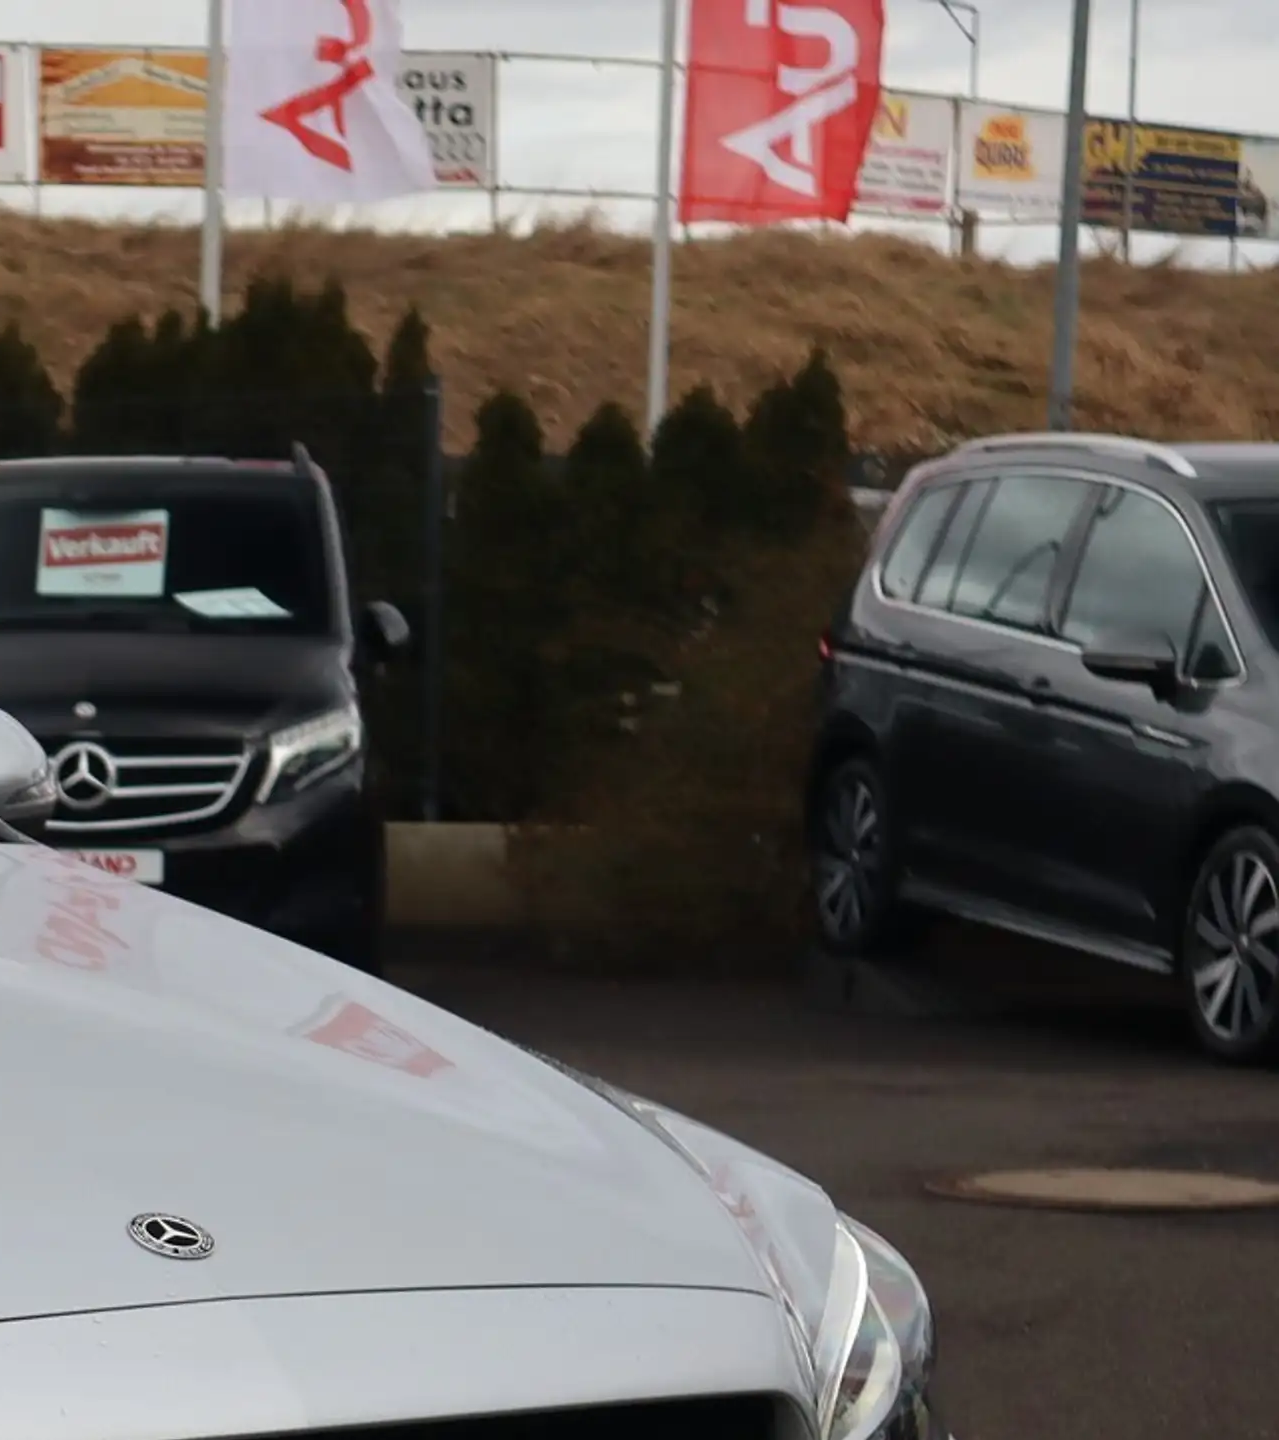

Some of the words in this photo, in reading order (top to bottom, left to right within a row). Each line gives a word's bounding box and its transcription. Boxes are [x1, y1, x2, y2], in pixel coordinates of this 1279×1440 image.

[396, 68, 468, 91] aus
[717, 0, 859, 199] AU
[47, 529, 161, 560] Verkauft
